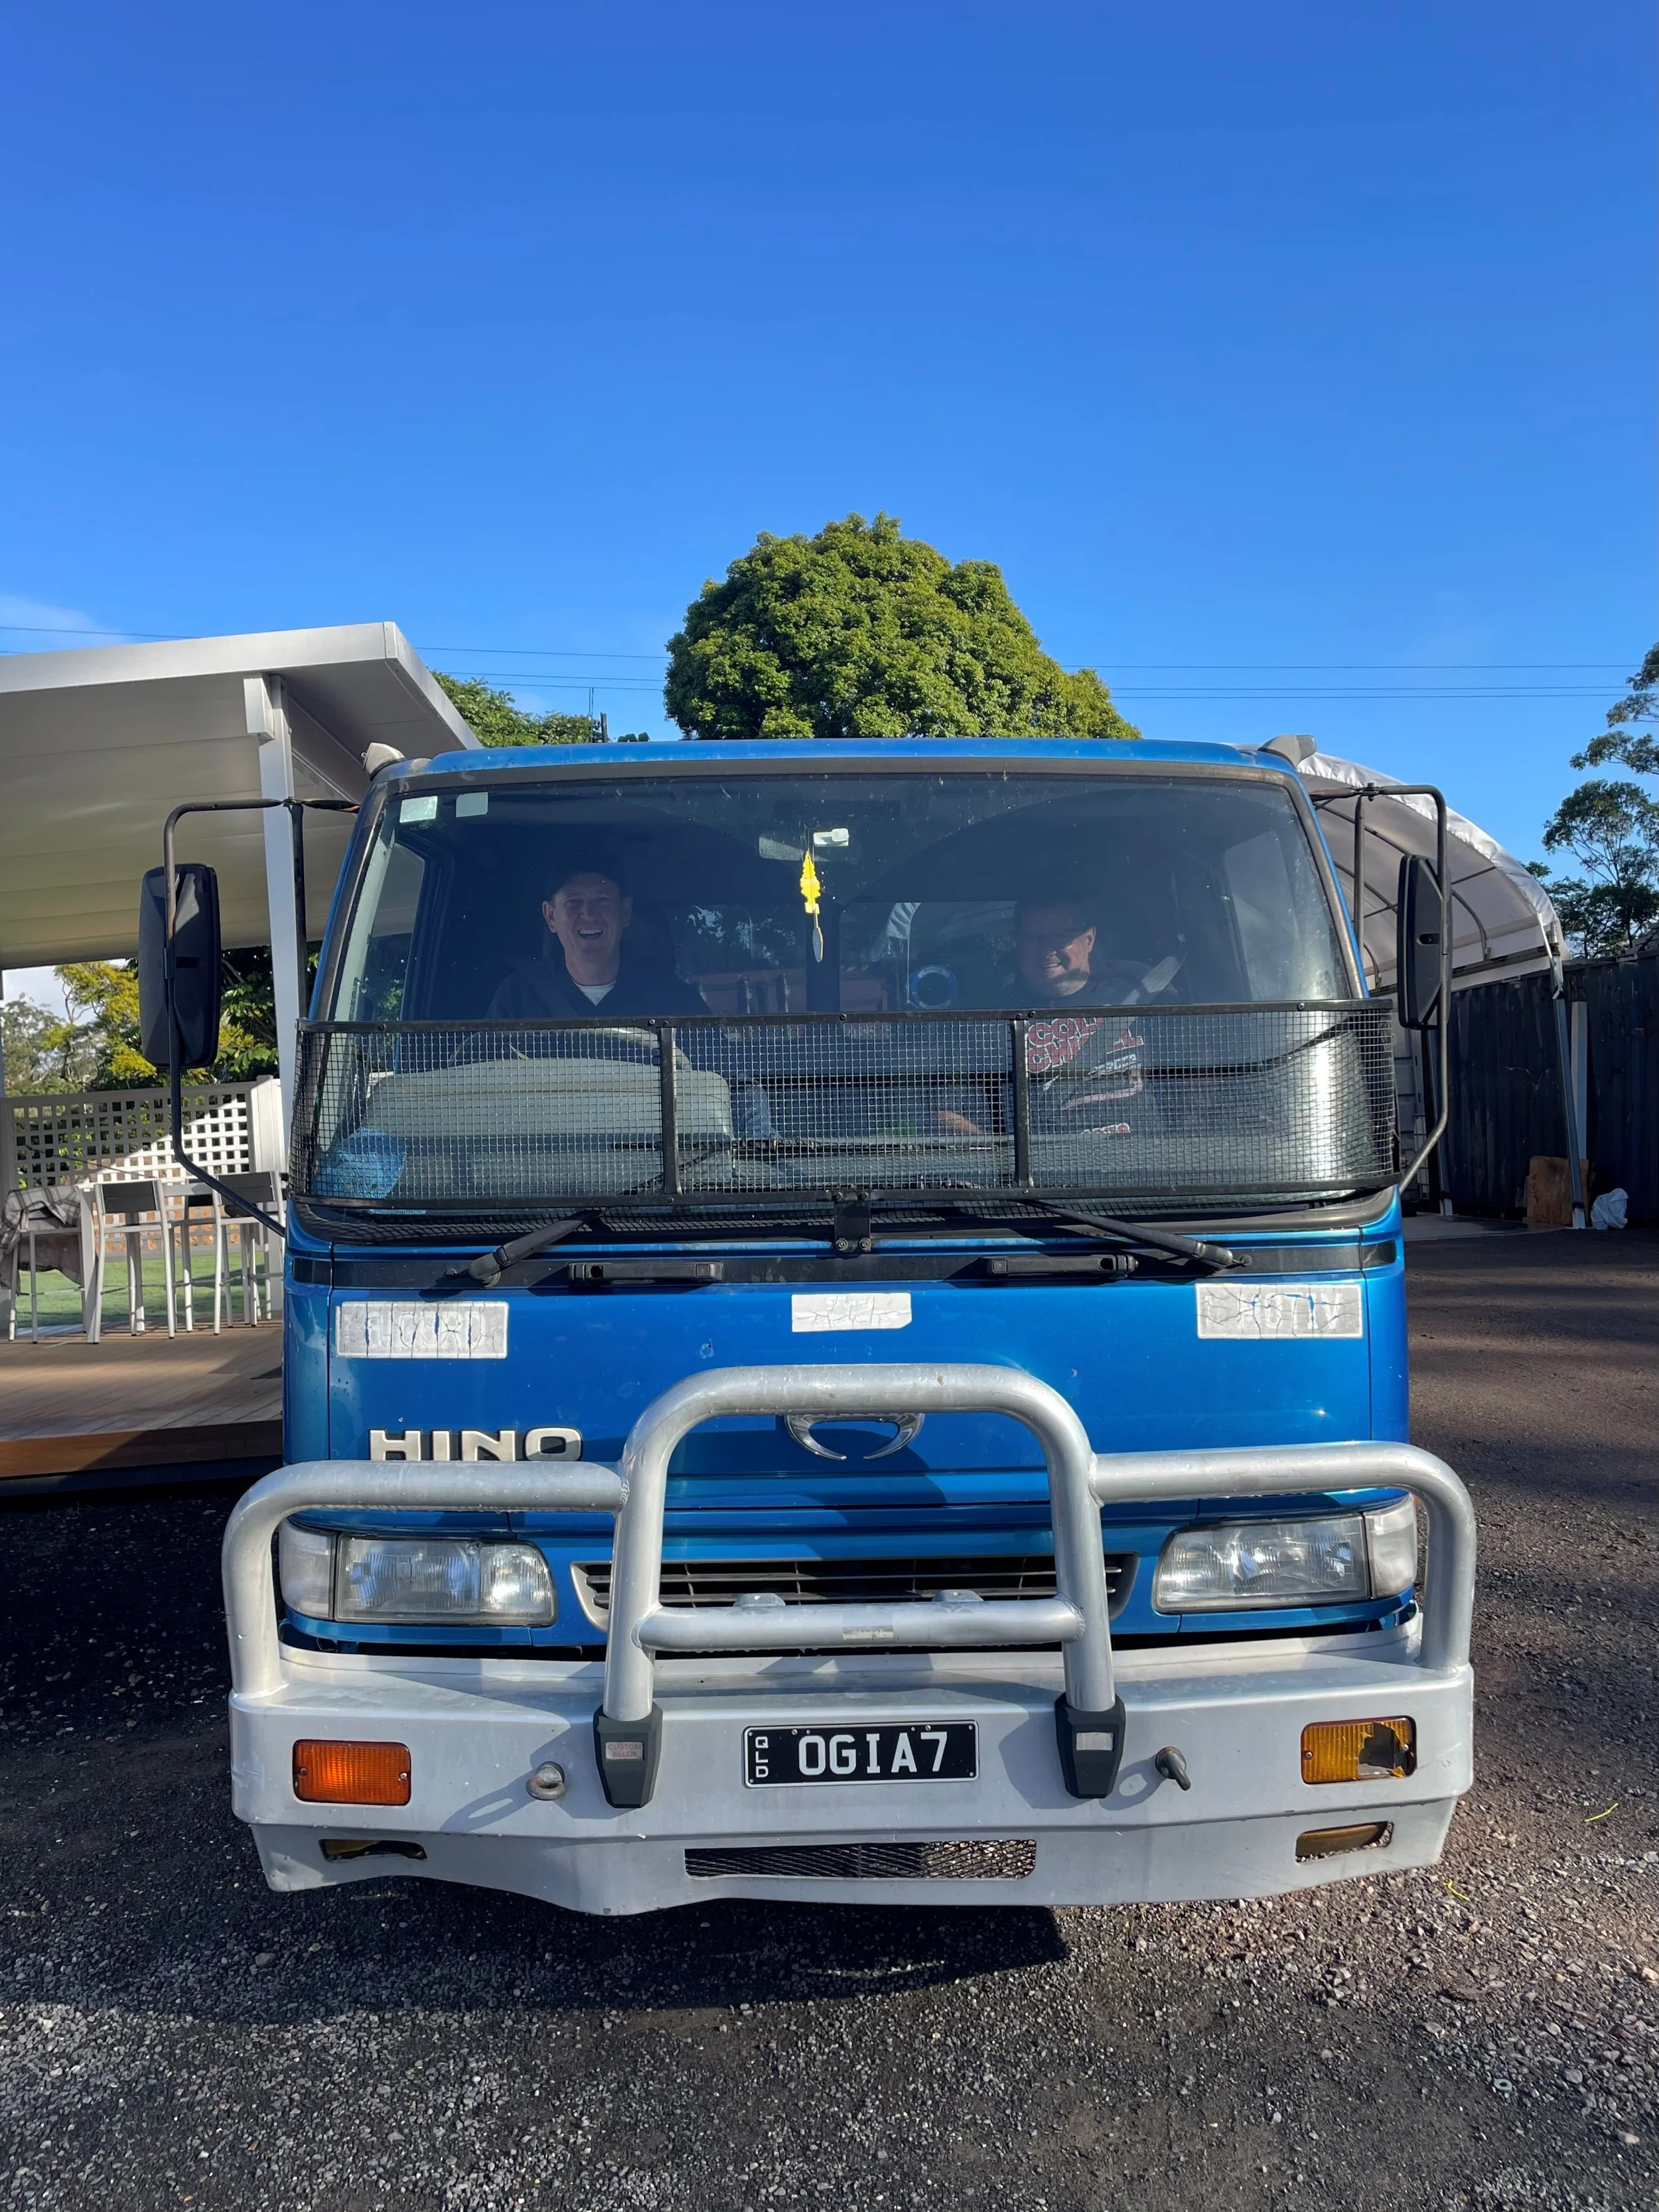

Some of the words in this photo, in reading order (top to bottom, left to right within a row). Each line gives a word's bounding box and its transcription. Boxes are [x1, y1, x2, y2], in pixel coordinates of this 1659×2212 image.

[1028, 1017, 1104, 1047] COL
[370, 1427, 582, 1461] HINO
[755, 1736, 768, 1778] QLD
